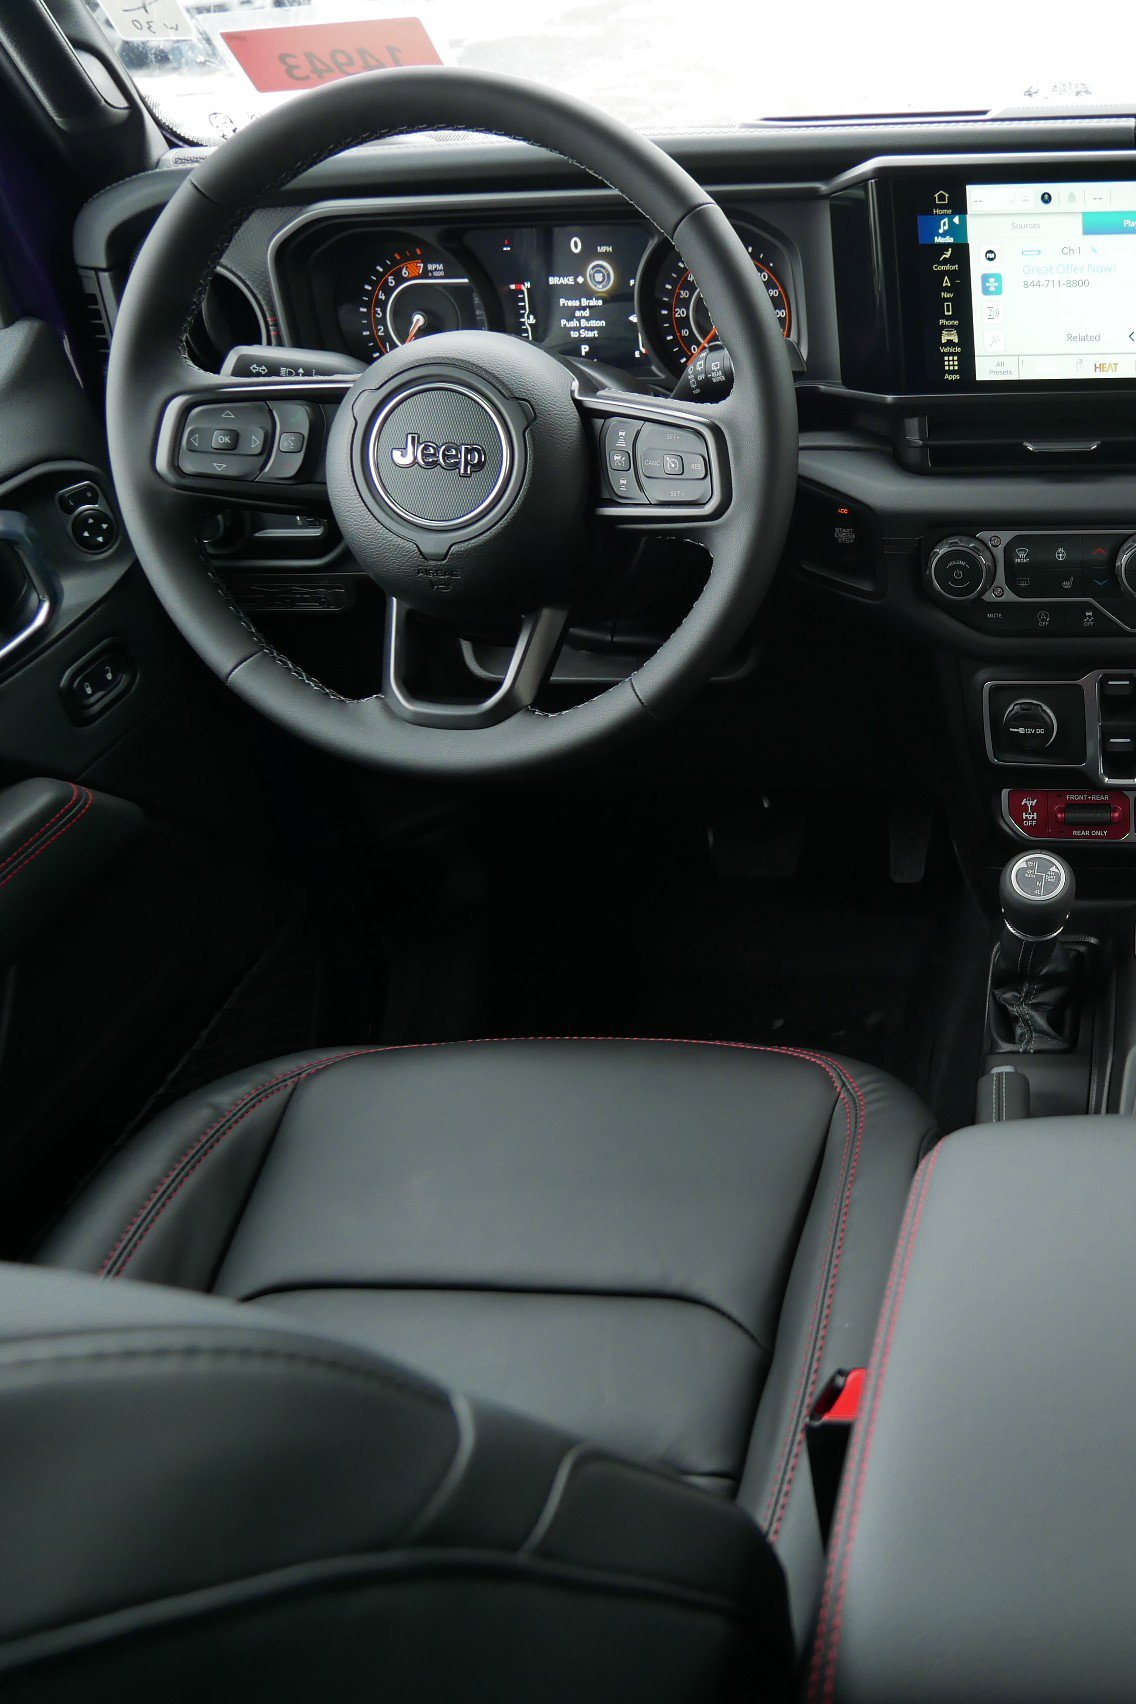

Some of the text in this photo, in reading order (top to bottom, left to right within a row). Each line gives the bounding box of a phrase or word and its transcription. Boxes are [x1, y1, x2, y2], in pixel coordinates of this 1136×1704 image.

[933, 207, 952, 215] Home
[1011, 222, 1041, 230] Sources
[934, 235, 954, 243] Media
[570, 236, 582, 254] 0
[597, 245, 613, 253] MPH
[1061, 247, 1081, 255] Ch 1
[417, 263, 423, 273] 7
[427, 263, 444, 271] RPM
[933, 263, 959, 271] Comfort
[1022, 263, 1116, 275] Great Offer Now!
[401, 267, 408, 277] 6
[388, 276, 395, 286] 5
[548, 275, 575, 285] BRAKE
[1023, 279, 1090, 289] 844-711-8800
[378, 291, 385, 300] 4
[680, 289, 689, 299] 30
[768, 288, 779, 298] 90
[559, 297, 603, 307] Press Brake
[375, 308, 382, 317] 3
[574, 308, 590, 317] and
[675, 308, 687, 317] 20
[560, 318, 606, 328] Push Button
[378, 326, 385, 335] 2
[570, 328, 598, 337] to Start
[681, 328, 689, 337] 10
[1066, 333, 1101, 342] Related
[581, 344, 590, 356] P
[690, 345, 698, 354] 0
[1094, 363, 1119, 373] HEAT
[218, 435, 231, 443] OK
[390, 432, 487, 477] Jeep
